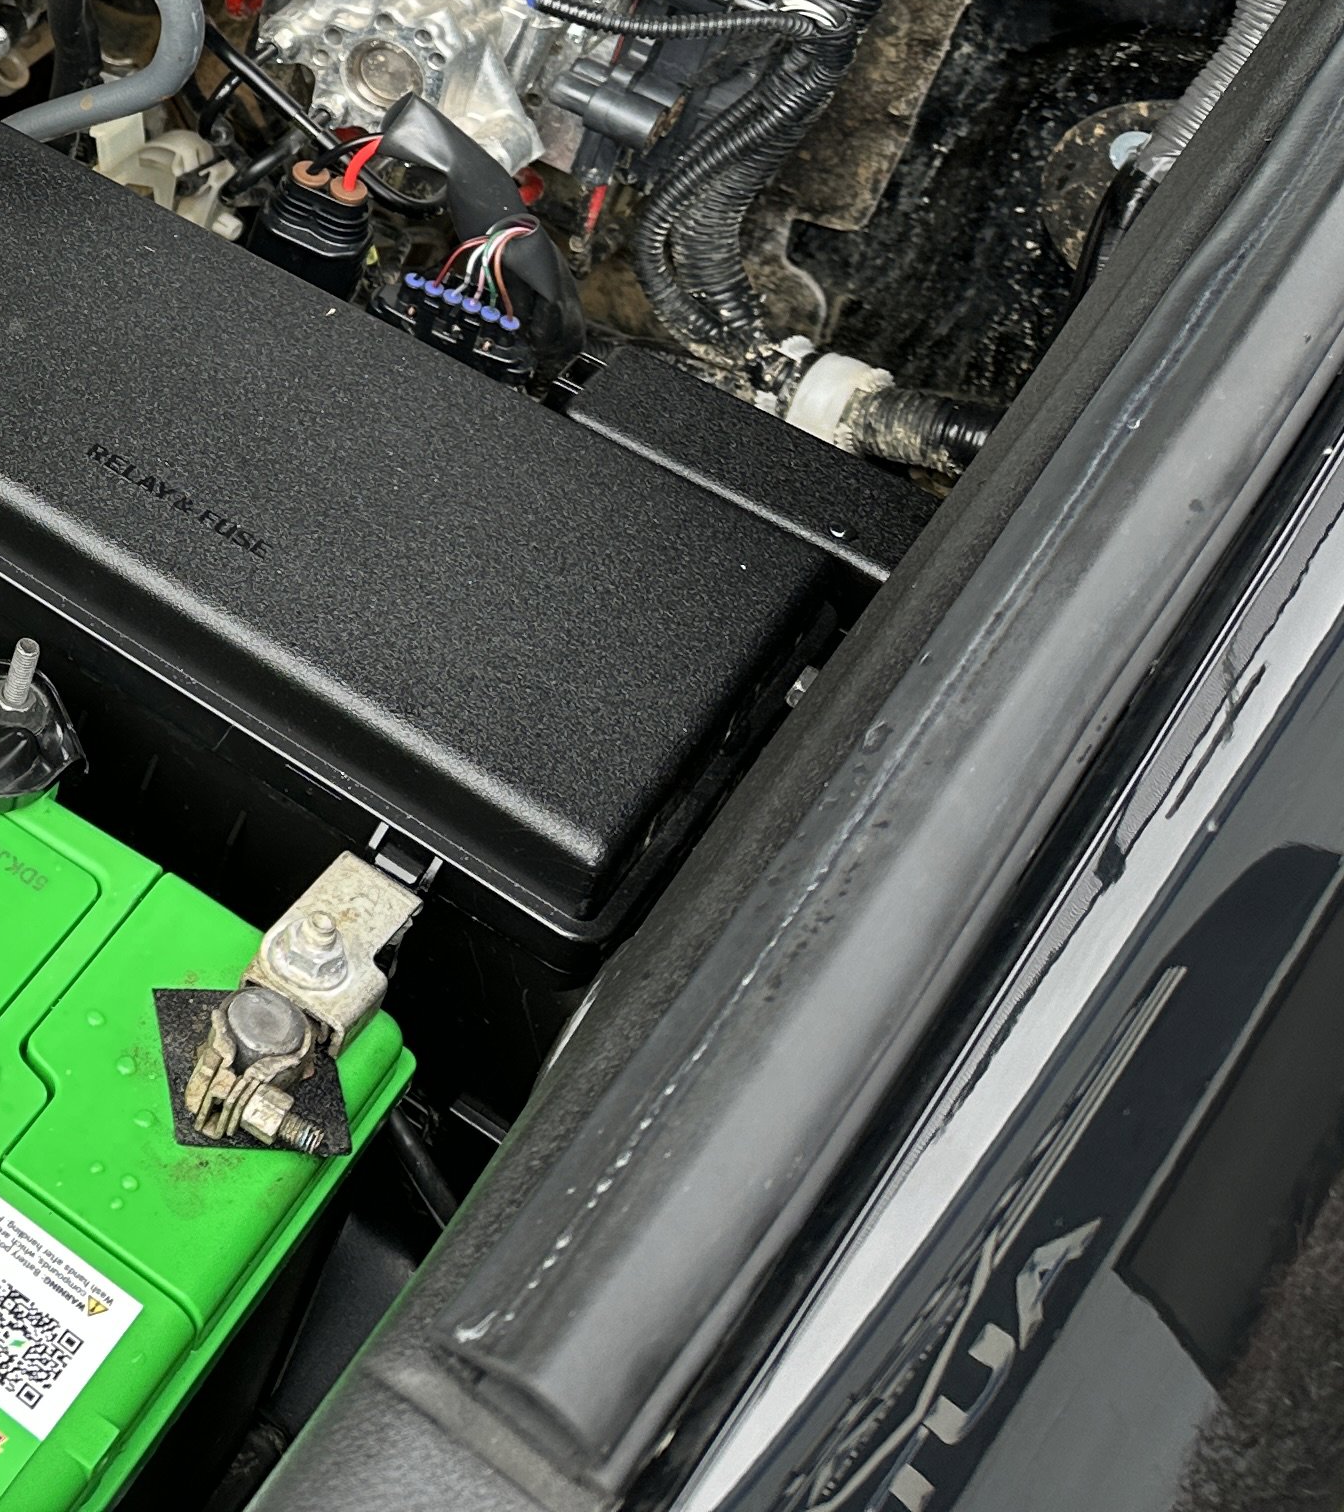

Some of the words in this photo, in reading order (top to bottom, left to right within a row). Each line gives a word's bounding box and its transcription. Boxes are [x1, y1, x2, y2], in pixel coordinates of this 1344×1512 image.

[85, 442, 174, 501] RELAY
[172, 492, 196, 514] &
[198, 508, 275, 561] FUSE
[10, 1250, 44, 1278] Battery
[42, 1248, 64, 1266] after
[64, 1264, 90, 1288] hands
[90, 1284, 114, 1306] Wash
